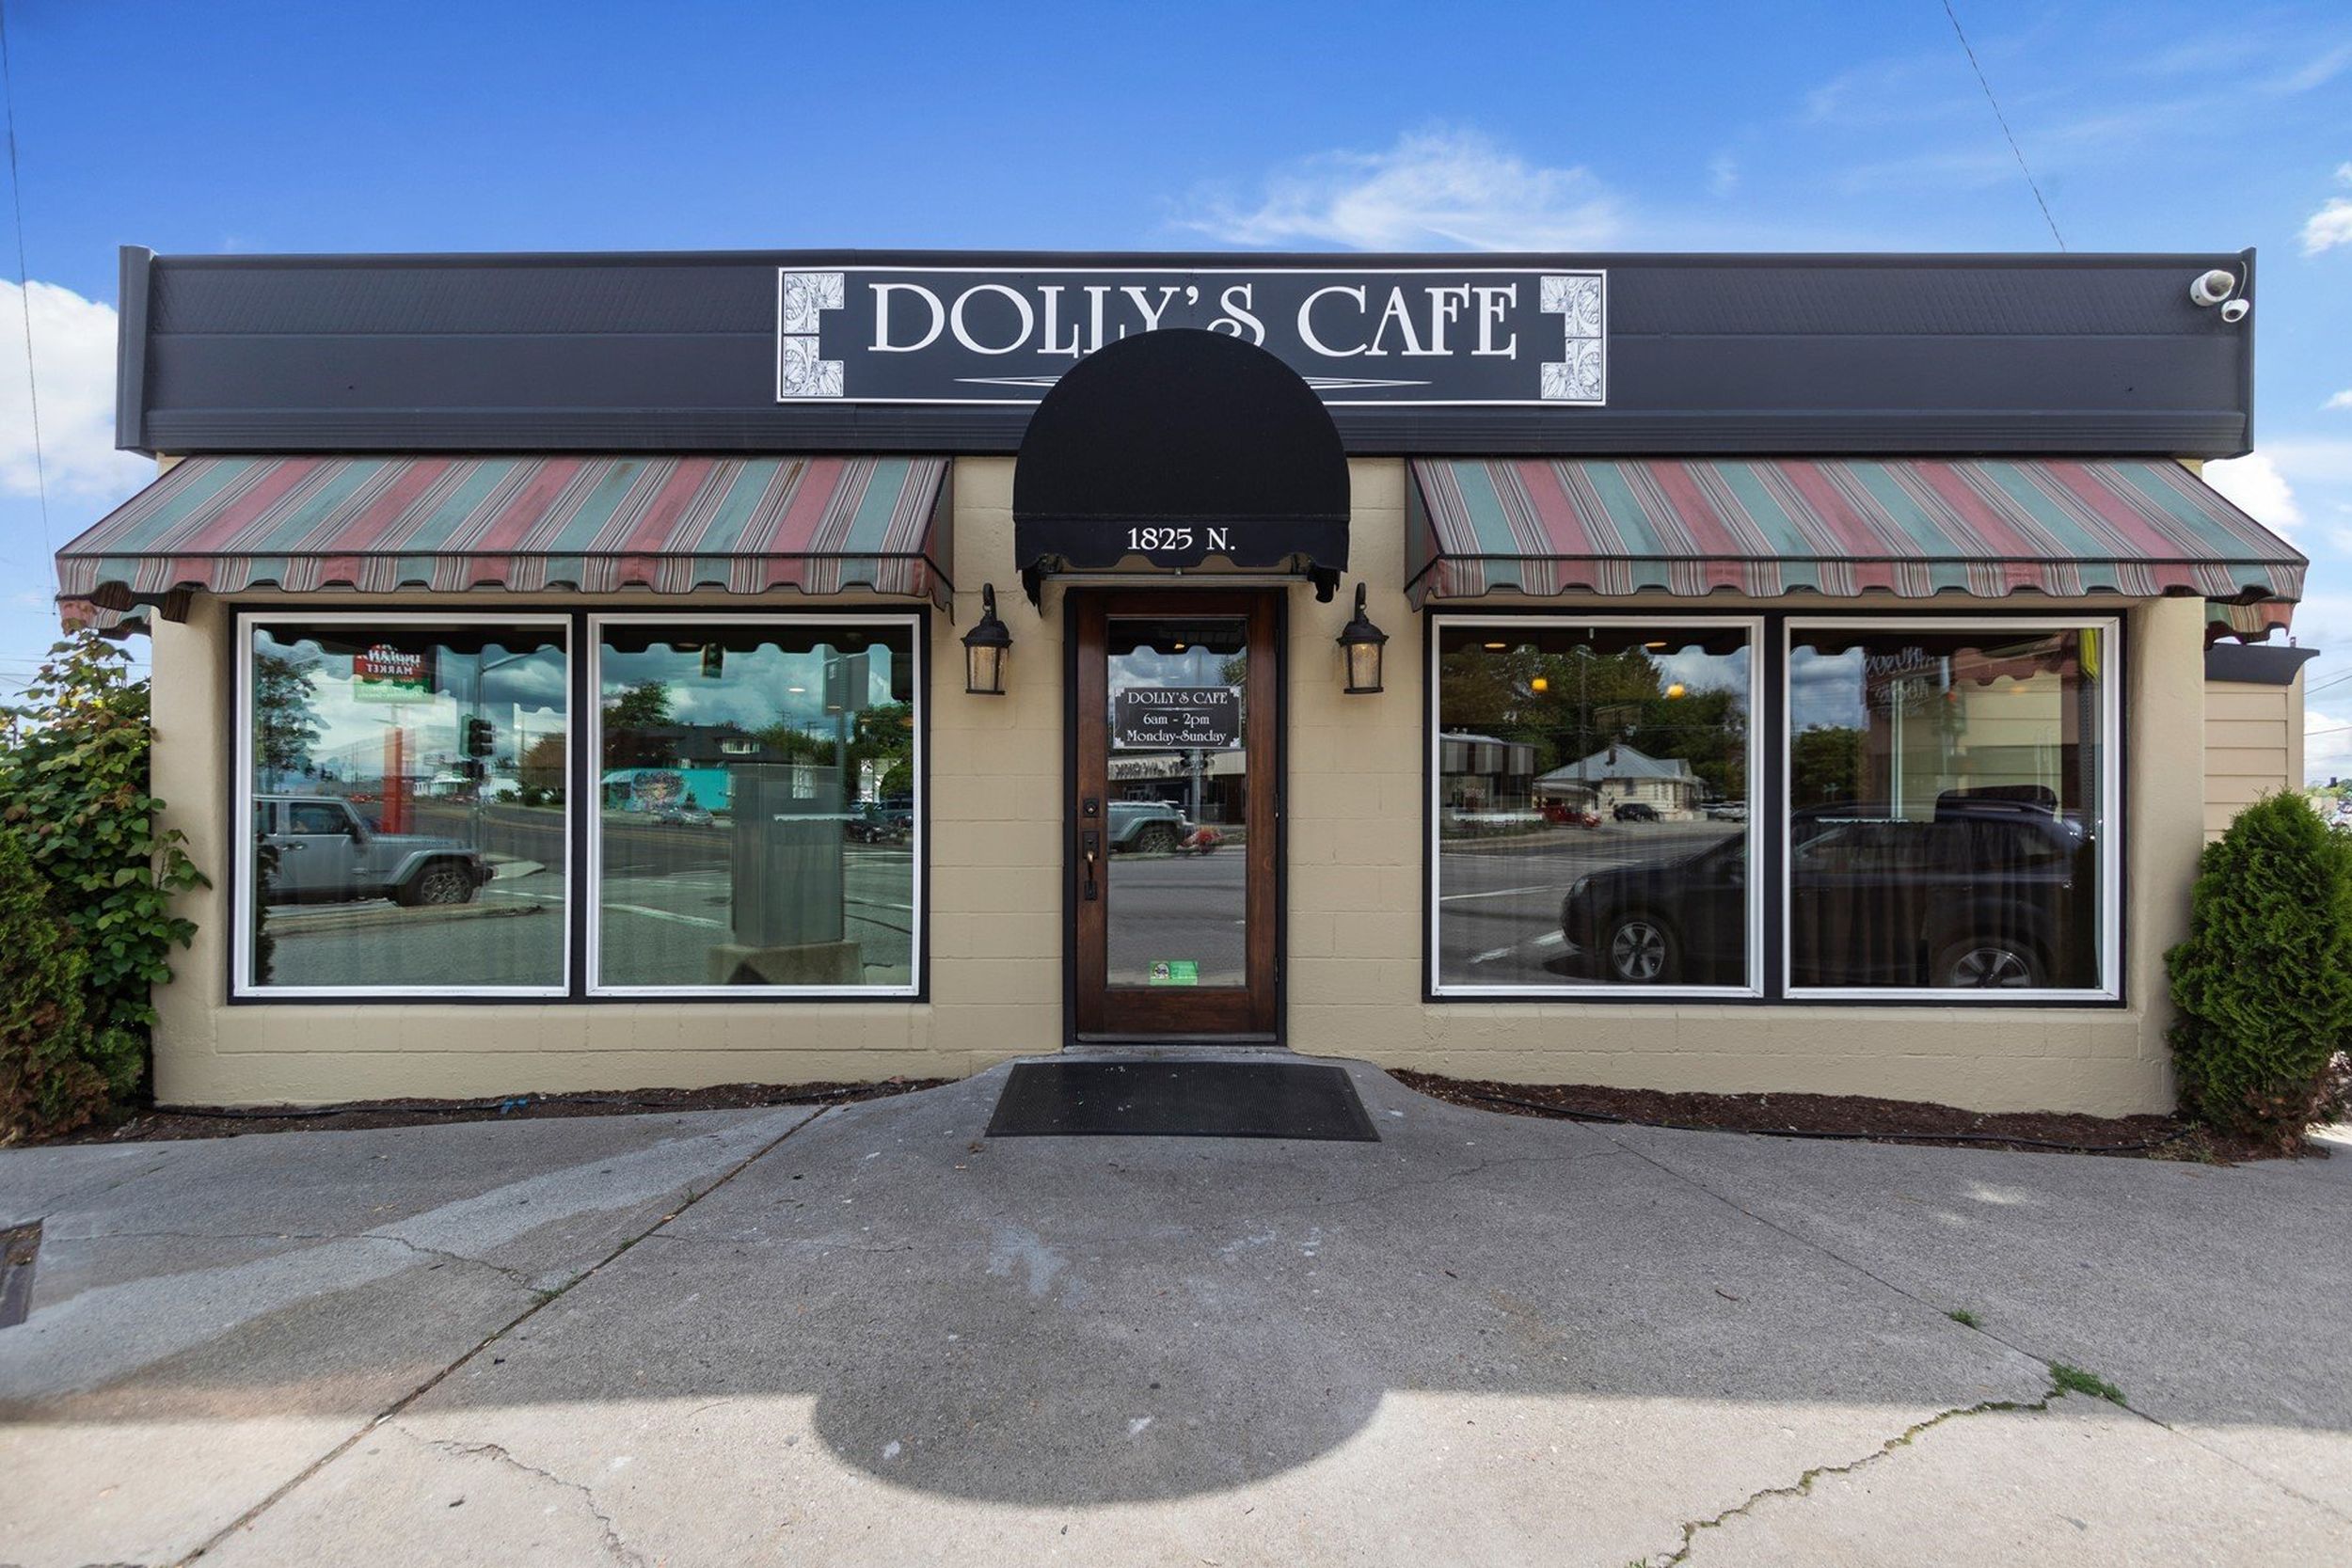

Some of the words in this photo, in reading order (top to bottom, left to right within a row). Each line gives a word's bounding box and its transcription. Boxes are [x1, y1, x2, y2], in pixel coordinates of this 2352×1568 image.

[868, 283, 1265, 358] DOLLY'S
[1297, 283, 1517, 359] CAFE
[1127, 527, 1193, 550] 1825
[1206, 527, 1235, 550] N.
[1128, 691, 1189, 705] DOLLY'S
[1193, 691, 1228, 705] CAFE
[1143, 713, 1168, 725] 6am
[1184, 713, 1210, 728] 2pm
[1127, 730, 1227, 745] Monday-Sunday
